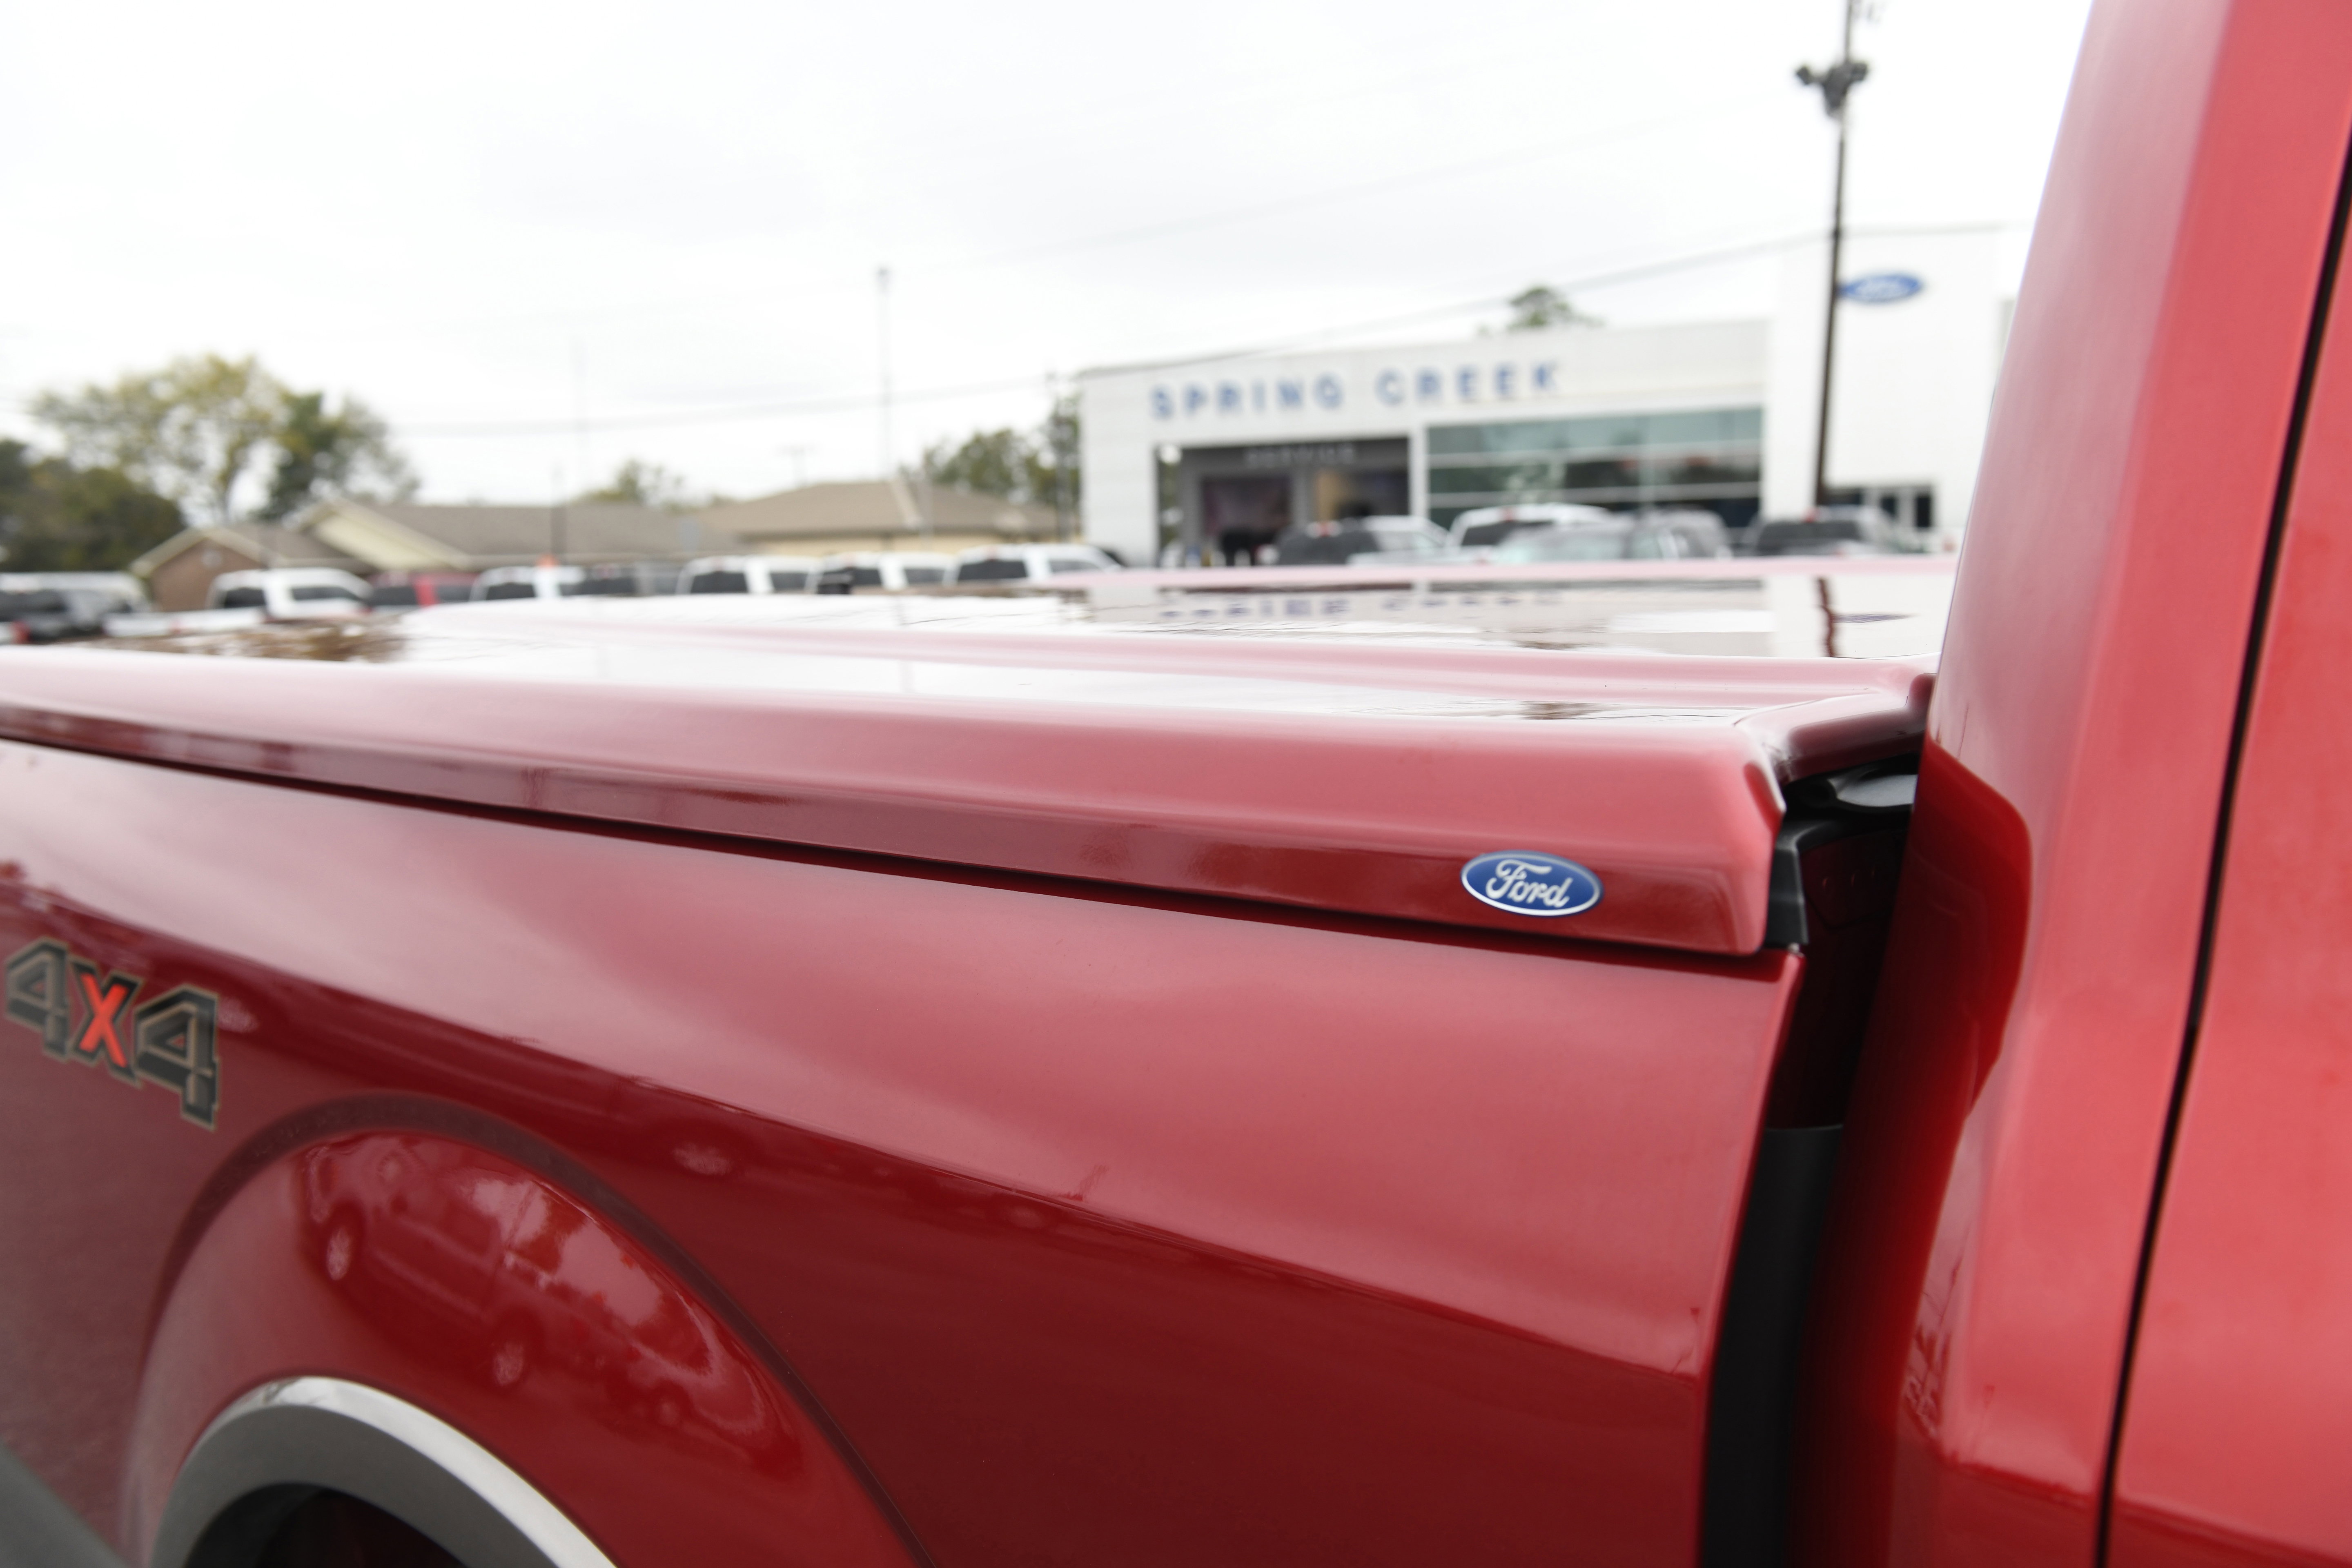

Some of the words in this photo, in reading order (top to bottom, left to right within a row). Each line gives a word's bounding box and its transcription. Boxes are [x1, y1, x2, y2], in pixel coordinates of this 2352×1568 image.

[1151, 375, 1343, 416] SPRING
[1376, 363, 1561, 405] CREEK
[1485, 859, 1574, 908] Ford
